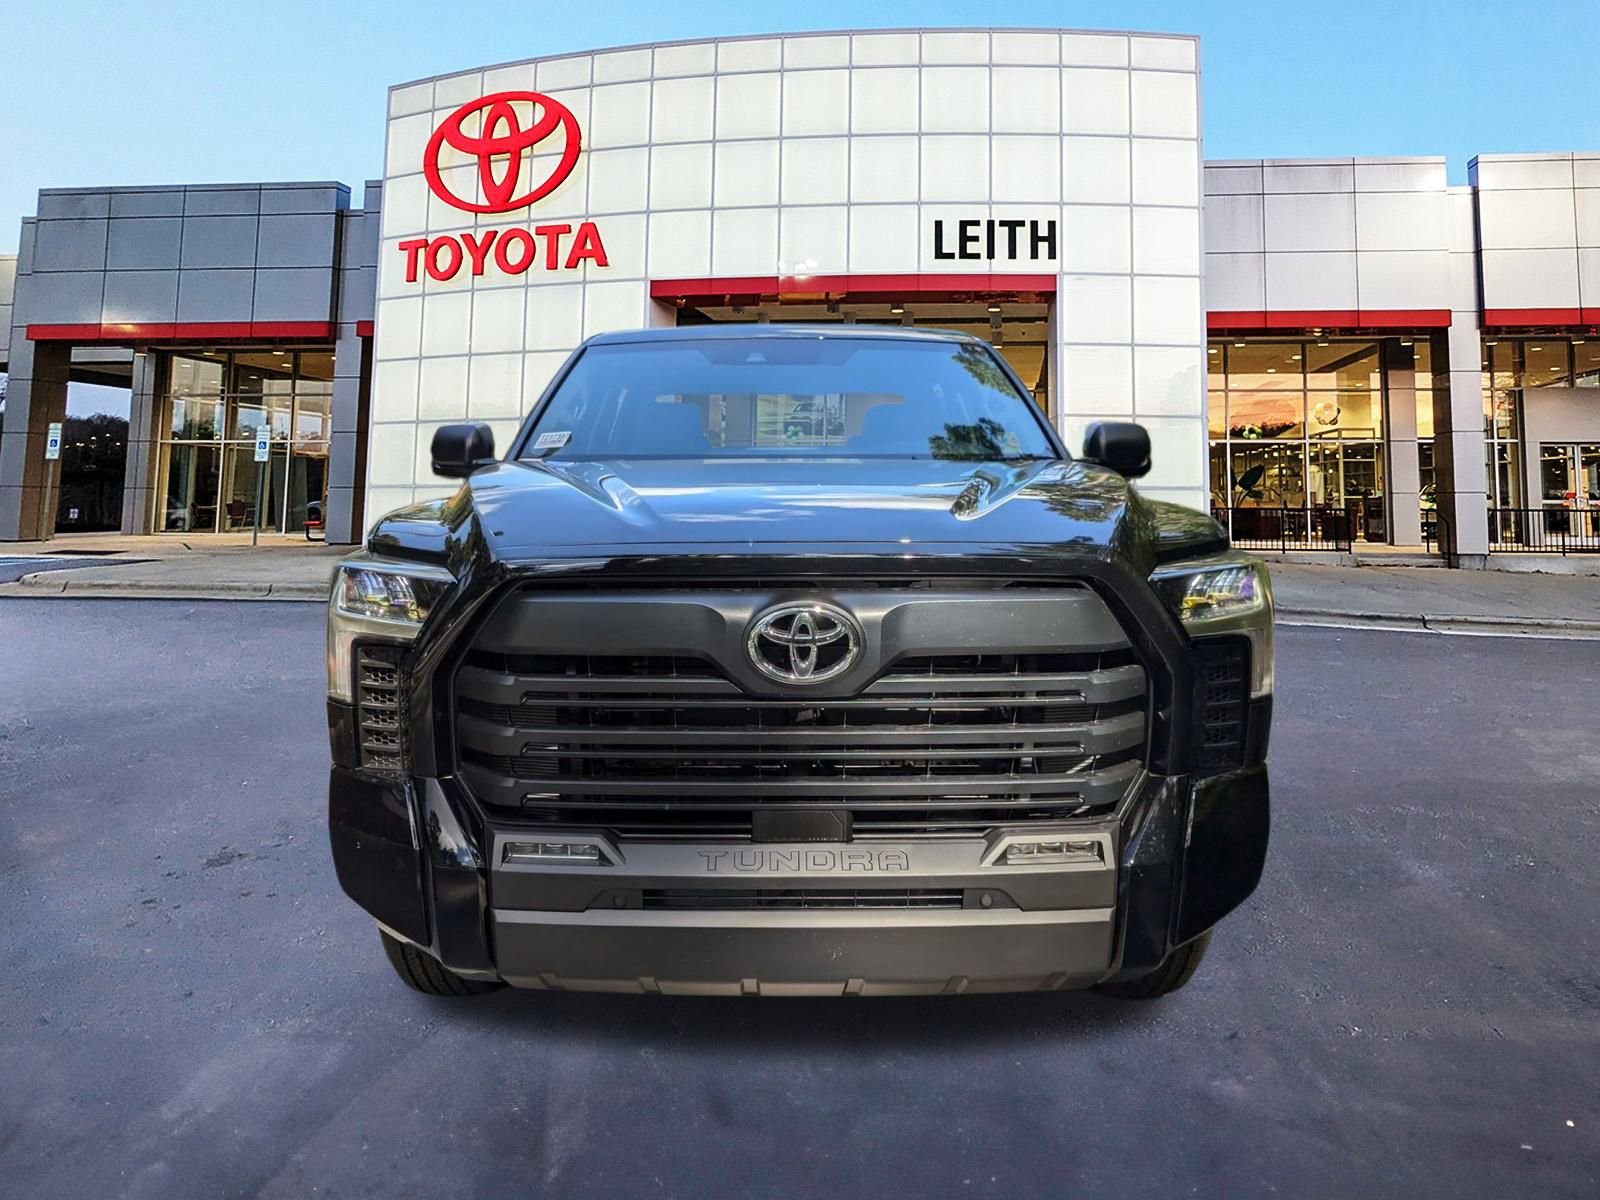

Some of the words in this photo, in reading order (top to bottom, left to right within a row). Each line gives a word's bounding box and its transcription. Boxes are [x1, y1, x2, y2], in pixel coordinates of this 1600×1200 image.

[398, 221, 610, 283] TOYOTA
[934, 219, 1057, 260] LEITH
[697, 850, 909, 871] TUNDRA
